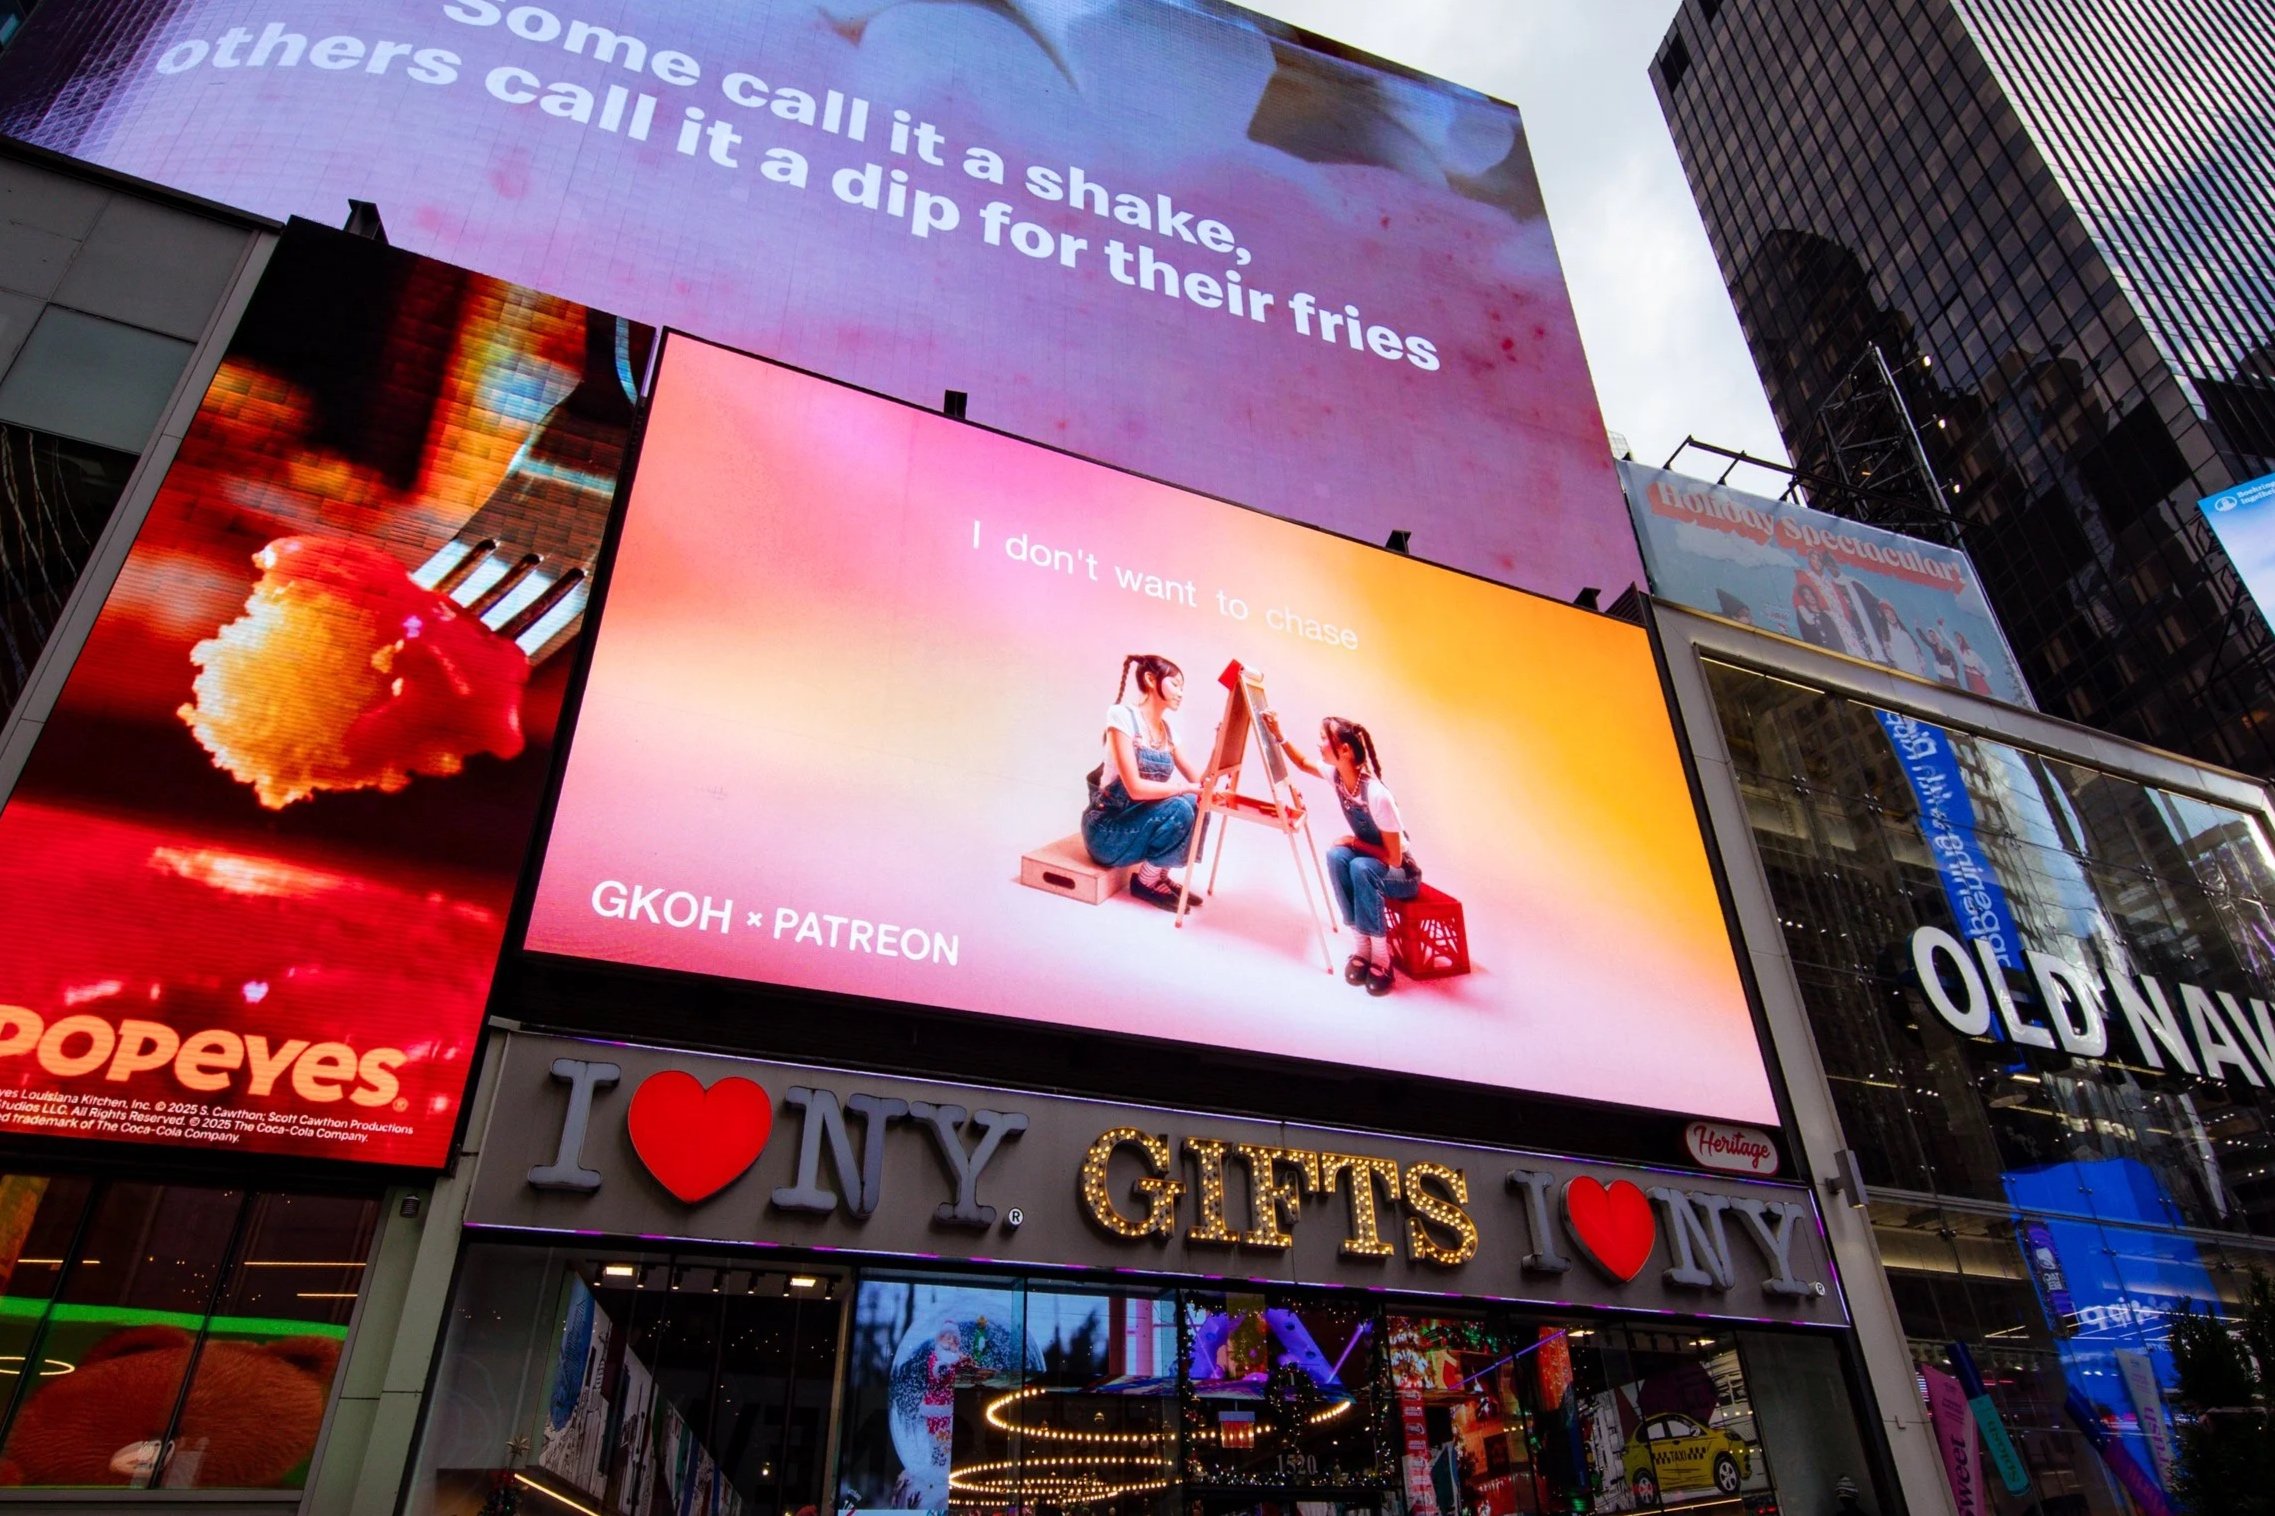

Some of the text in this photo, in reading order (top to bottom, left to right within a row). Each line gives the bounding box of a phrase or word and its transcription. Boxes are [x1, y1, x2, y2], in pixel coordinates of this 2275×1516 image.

[444, 0, 1252, 266] Some call it a shake,
[155, 23, 1440, 371] others call it a dip for their fries
[1654, 481, 1774, 537] Holiday
[972, 519, 1358, 651] I don't want to chase
[592, 880, 733, 934] GKOH
[773, 907, 959, 967] PATREON
[1910, 925, 2107, 1057] OLD
[12, 1112, 78, 1129] trademark
[80, 1118, 94, 1130] of
[96, 1120, 117, 1132] The
[120, 1122, 182, 1138] Coca-Cola
[184, 1127, 240, 1143] Company.
[21, 1088, 79, 1104] Louisiana
[131, 1100, 151, 1111] Inc.
[167, 1103, 198, 1115] 2025
[268, 1111, 297, 1124] Scott
[300, 1114, 348, 1129] Cawthon
[350, 1119, 413, 1135] Productions
[42, 1103, 68, 1116] LLC.
[71, 1106, 88, 1117] All
[88, 1108, 127, 1121] Rights
[129, 1111, 185, 1126] Reserved.
[201, 1117, 231, 1130] 2025
[234, 1120, 253, 1132] The
[256, 1122, 314, 1137] Coca-Cola
[316, 1127, 368, 1143] Company.
[528, 1057, 621, 1193] I
[1693, 1124, 1771, 1169] Heritage
[1080, 1125, 1479, 1268] GIFTS
[1506, 1169, 1572, 1273] I
